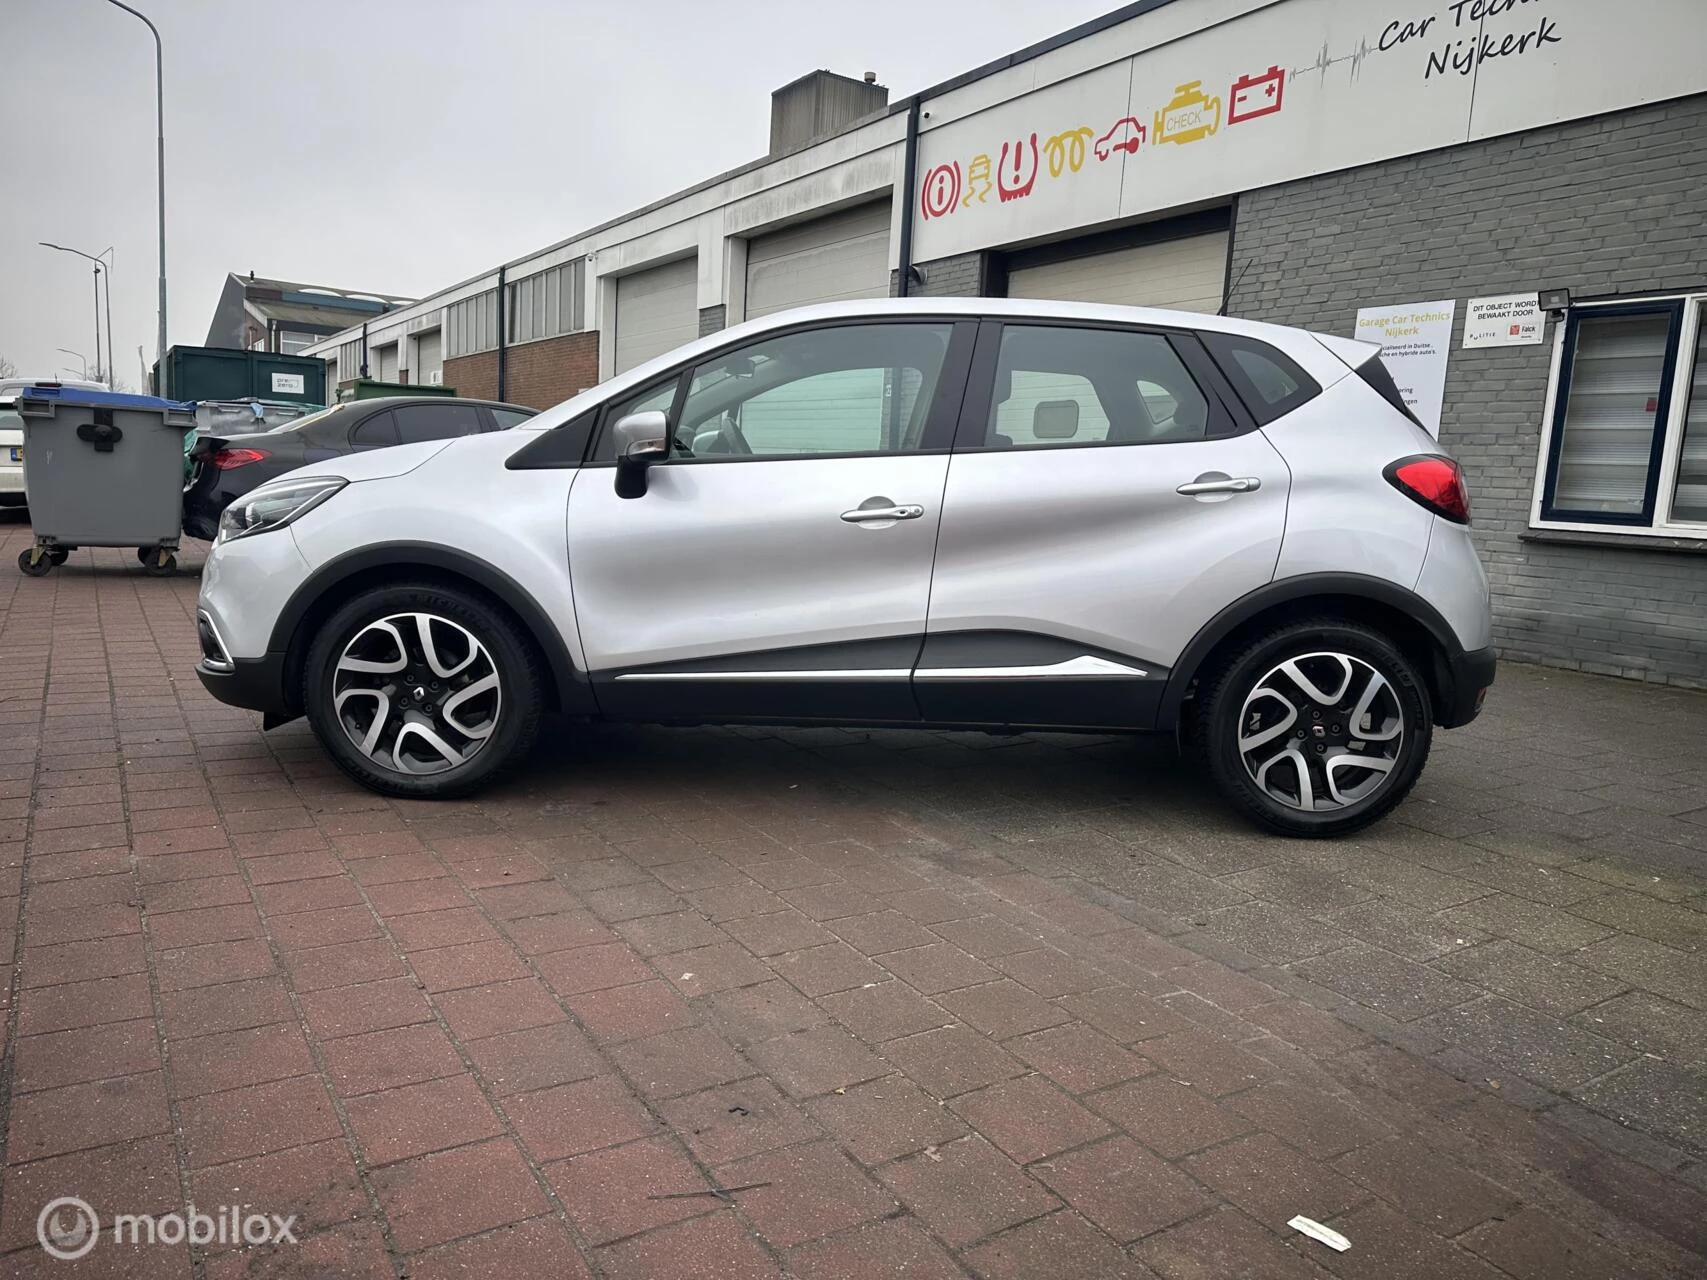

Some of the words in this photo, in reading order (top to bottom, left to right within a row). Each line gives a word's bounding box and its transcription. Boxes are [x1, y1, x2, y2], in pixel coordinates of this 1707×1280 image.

[1378, 16, 1436, 51] Car
[1424, 17, 1562, 79] Nijkerk
[1166, 109, 1202, 132] CHECK
[1477, 311, 1510, 320] BEWAAKT
[1512, 309, 1533, 317] DOOR
[1486, 303, 1512, 311] OBJECT
[1359, 317, 1390, 327] Garage
[1392, 315, 1407, 324] Car
[1410, 311, 1450, 323] Technics
[1385, 327, 1419, 338] Nijkerk
